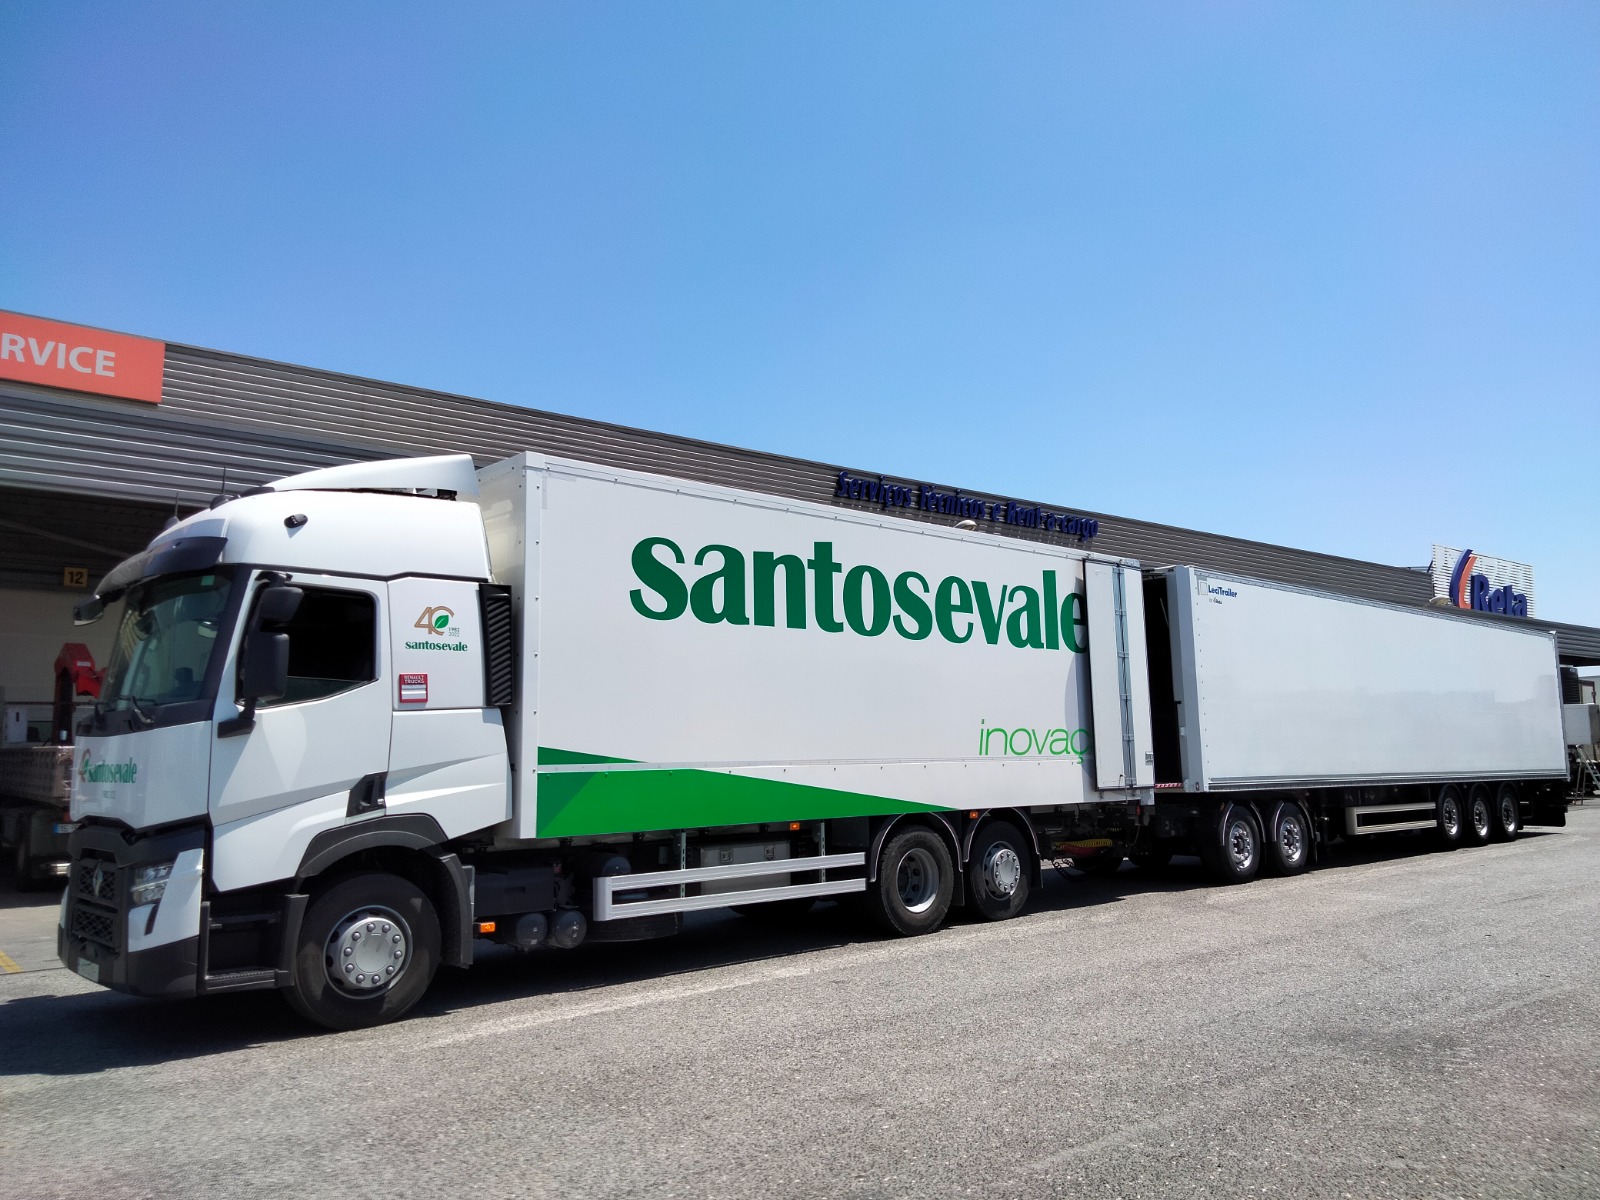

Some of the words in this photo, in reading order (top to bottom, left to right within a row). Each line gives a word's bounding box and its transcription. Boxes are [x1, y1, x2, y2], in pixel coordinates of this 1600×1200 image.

[1, 332, 116, 378] RVICE
[835, 471, 912, 508] Serviços
[918, 484, 987, 520] Técnicos
[990, 502, 1001, 522] e
[1006, 501, 1099, 542] Rent-a-cargo
[68, 571, 84, 585] 12
[629, 536, 1088, 654] santosevale
[1470, 573, 1528, 618] Reta
[405, 640, 468, 652] santosevale
